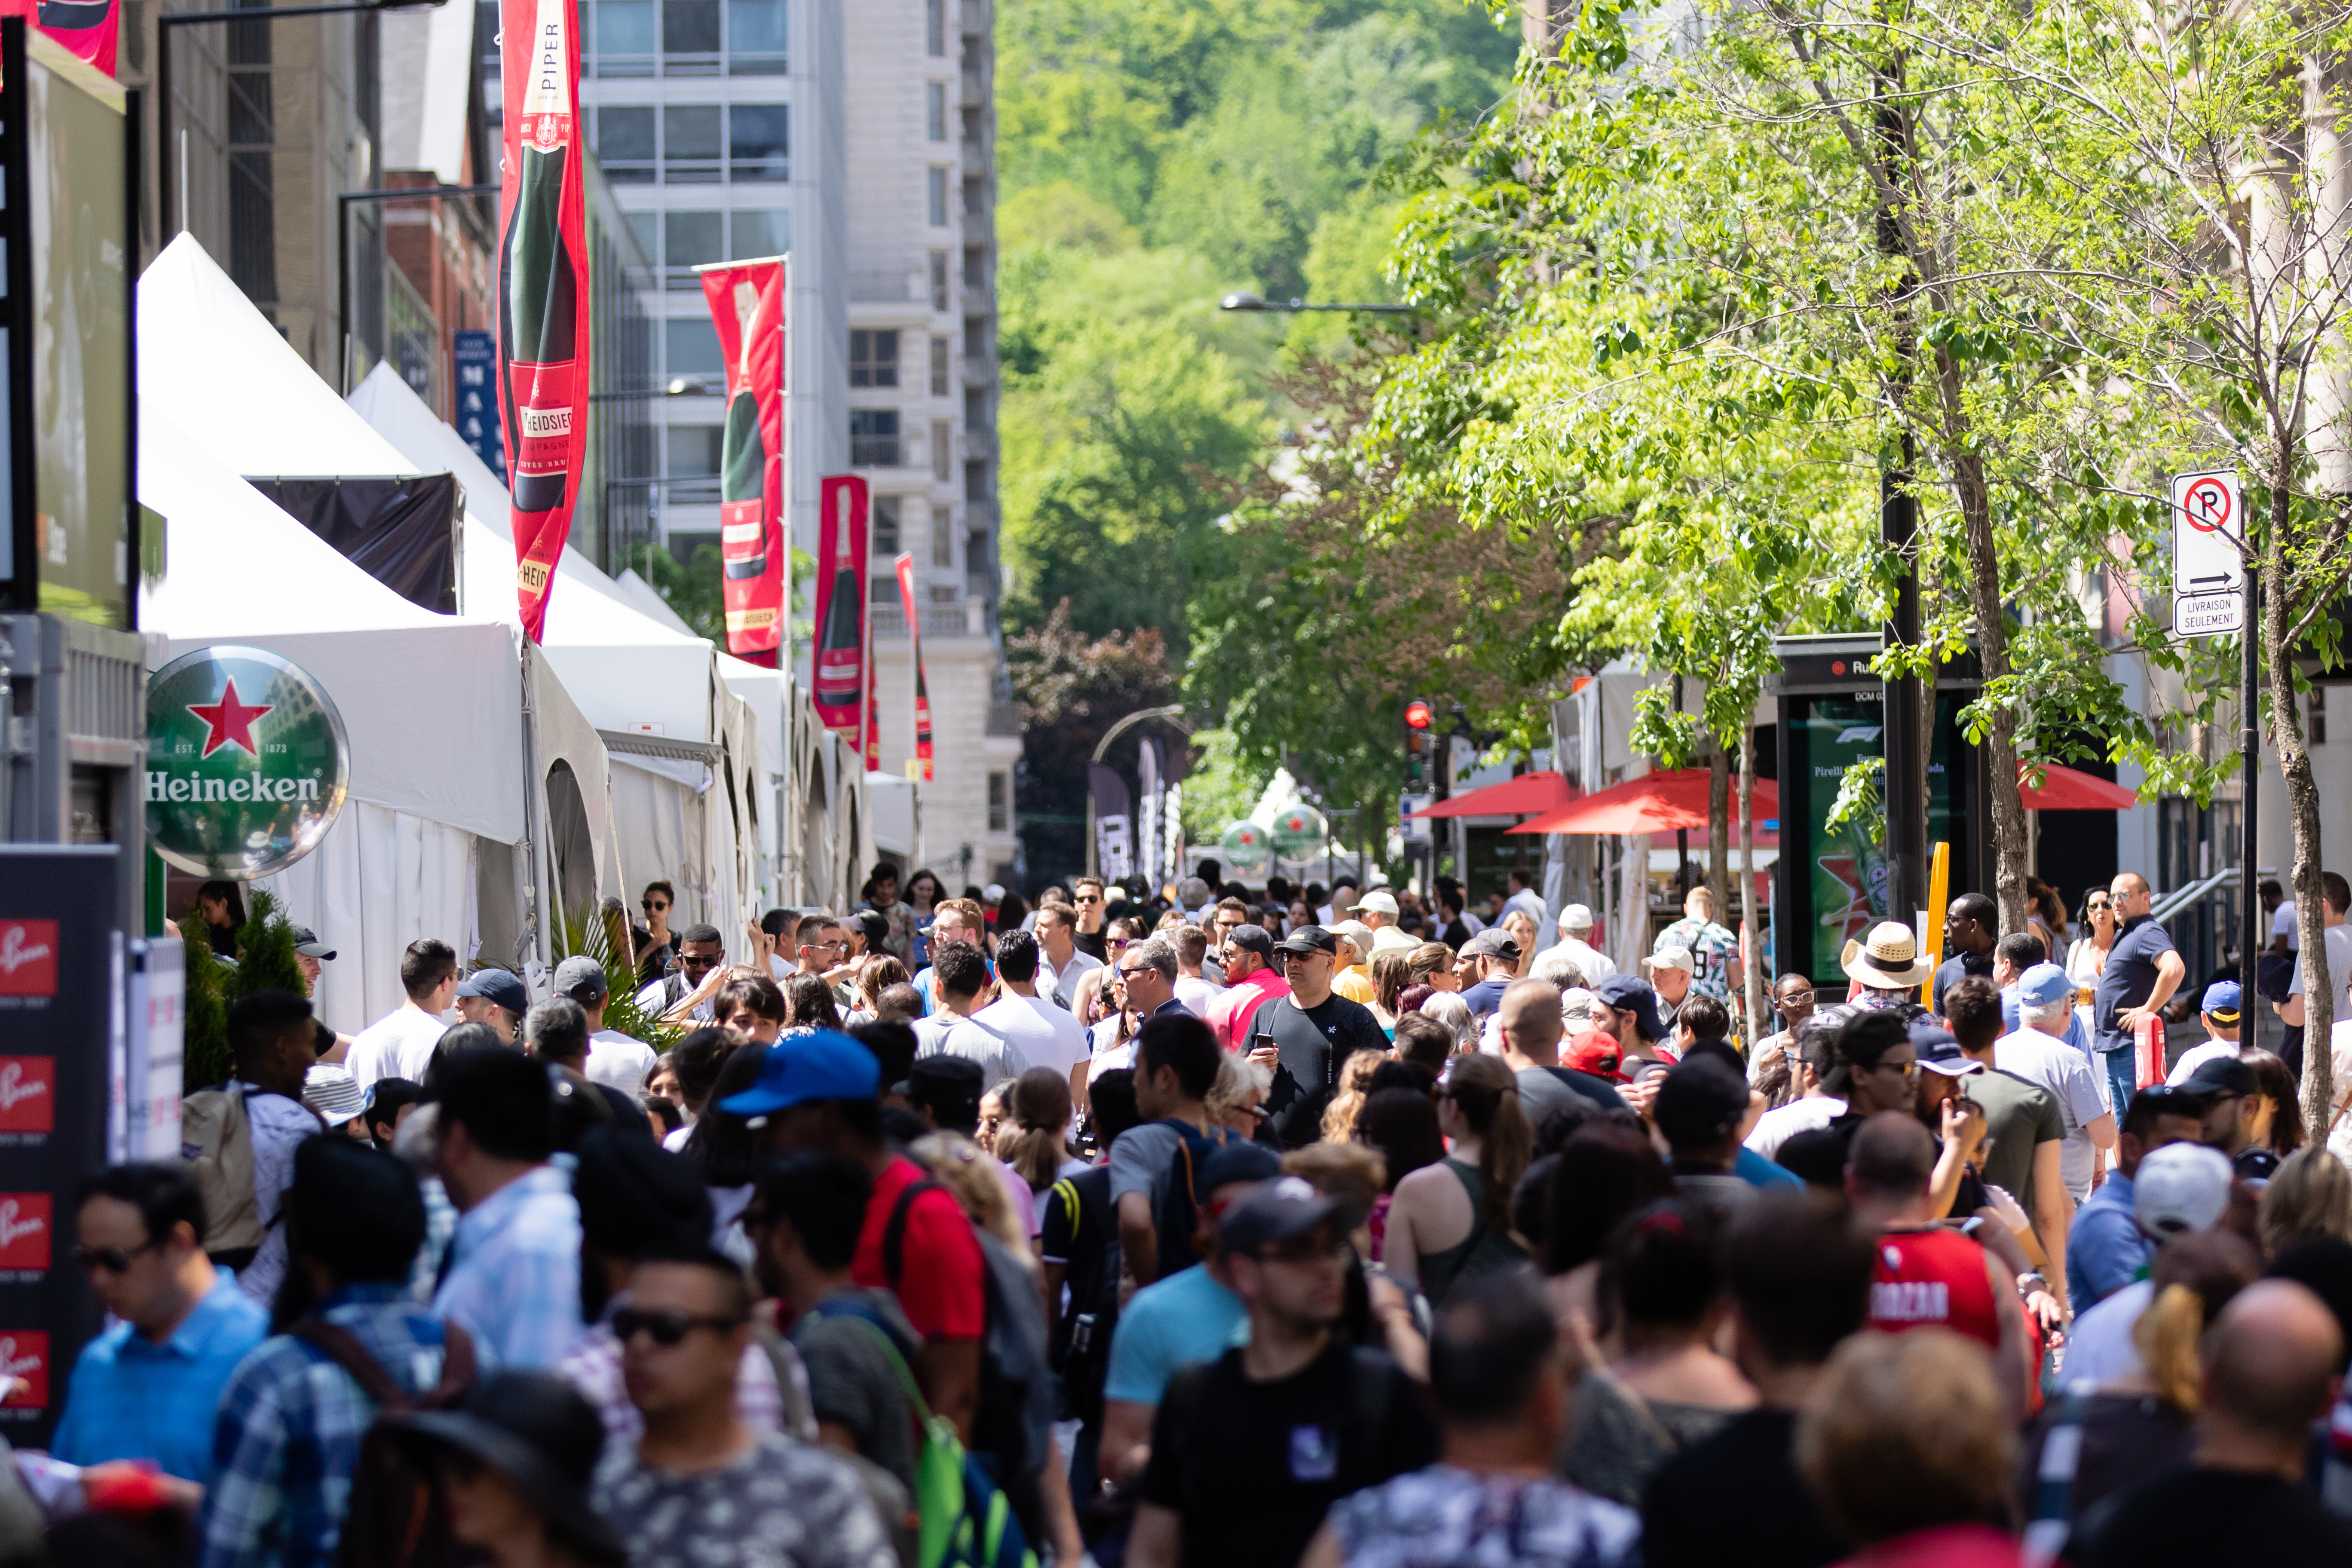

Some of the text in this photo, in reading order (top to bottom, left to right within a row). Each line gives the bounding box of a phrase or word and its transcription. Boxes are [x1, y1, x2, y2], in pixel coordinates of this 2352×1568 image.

[542, 24, 558, 90] PIPER
[561, 124, 570, 133] PIP
[527, 413, 572, 431] HEIDSIEC
[2188, 599, 2231, 613] LIVRAISON
[2185, 613, 2234, 628] SEULEMENT
[1853, 661, 1876, 674] Ru
[1855, 692, 1874, 701] DCM
[175, 744, 196, 753] EST.
[265, 744, 287, 753] 1873
[1814, 766, 1843, 776] Pirelli
[1928, 763, 1945, 772] ada
[144, 770, 321, 802] Heineken
